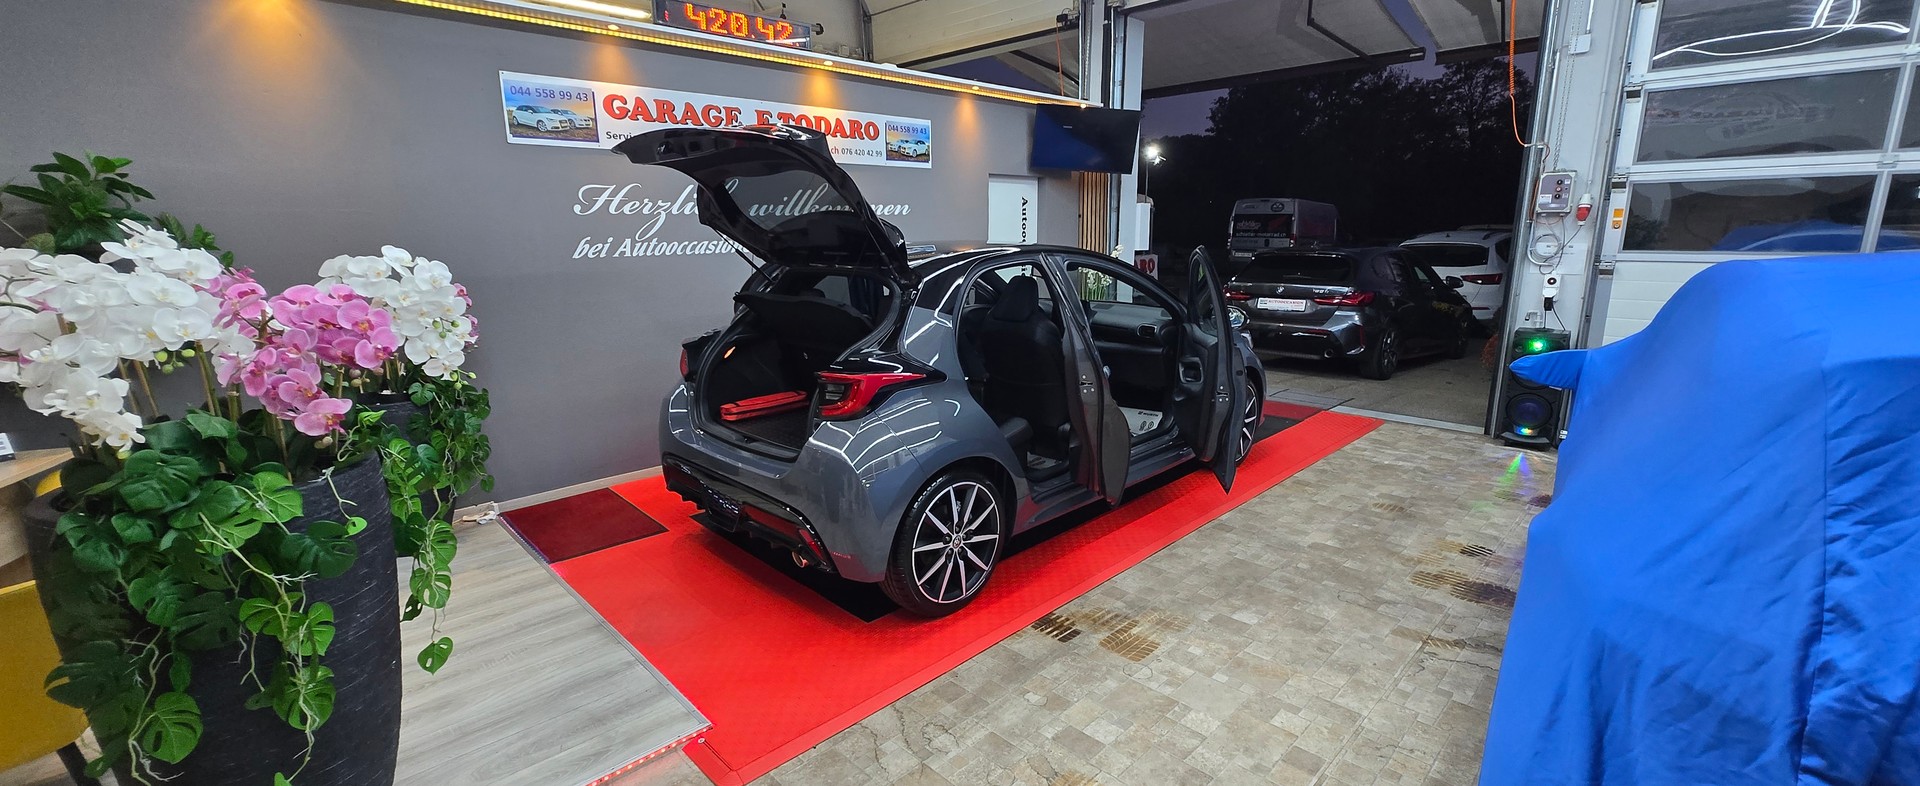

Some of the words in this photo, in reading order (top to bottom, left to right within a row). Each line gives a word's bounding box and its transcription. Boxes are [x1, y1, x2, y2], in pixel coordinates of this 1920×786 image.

[509, 85, 531, 97] 044
[535, 88, 555, 99] 558
[559, 91, 572, 101] 99
[575, 92, 588, 102] 43
[602, 94, 742, 128] GARAGE
[606, 130, 632, 140] Servi
[888, 124, 899, 132] 044
[900, 126, 911, 134] 558
[911, 126, 919, 135] 99
[920, 127, 927, 135] 43
[841, 147, 853, 156] 076
[854, 148, 865, 157] 420
[866, 149, 874, 157] 42
[573, 180, 738, 241] Herzli
[572, 236, 614, 259] bei
[613, 238, 751, 258] Autooccasion
